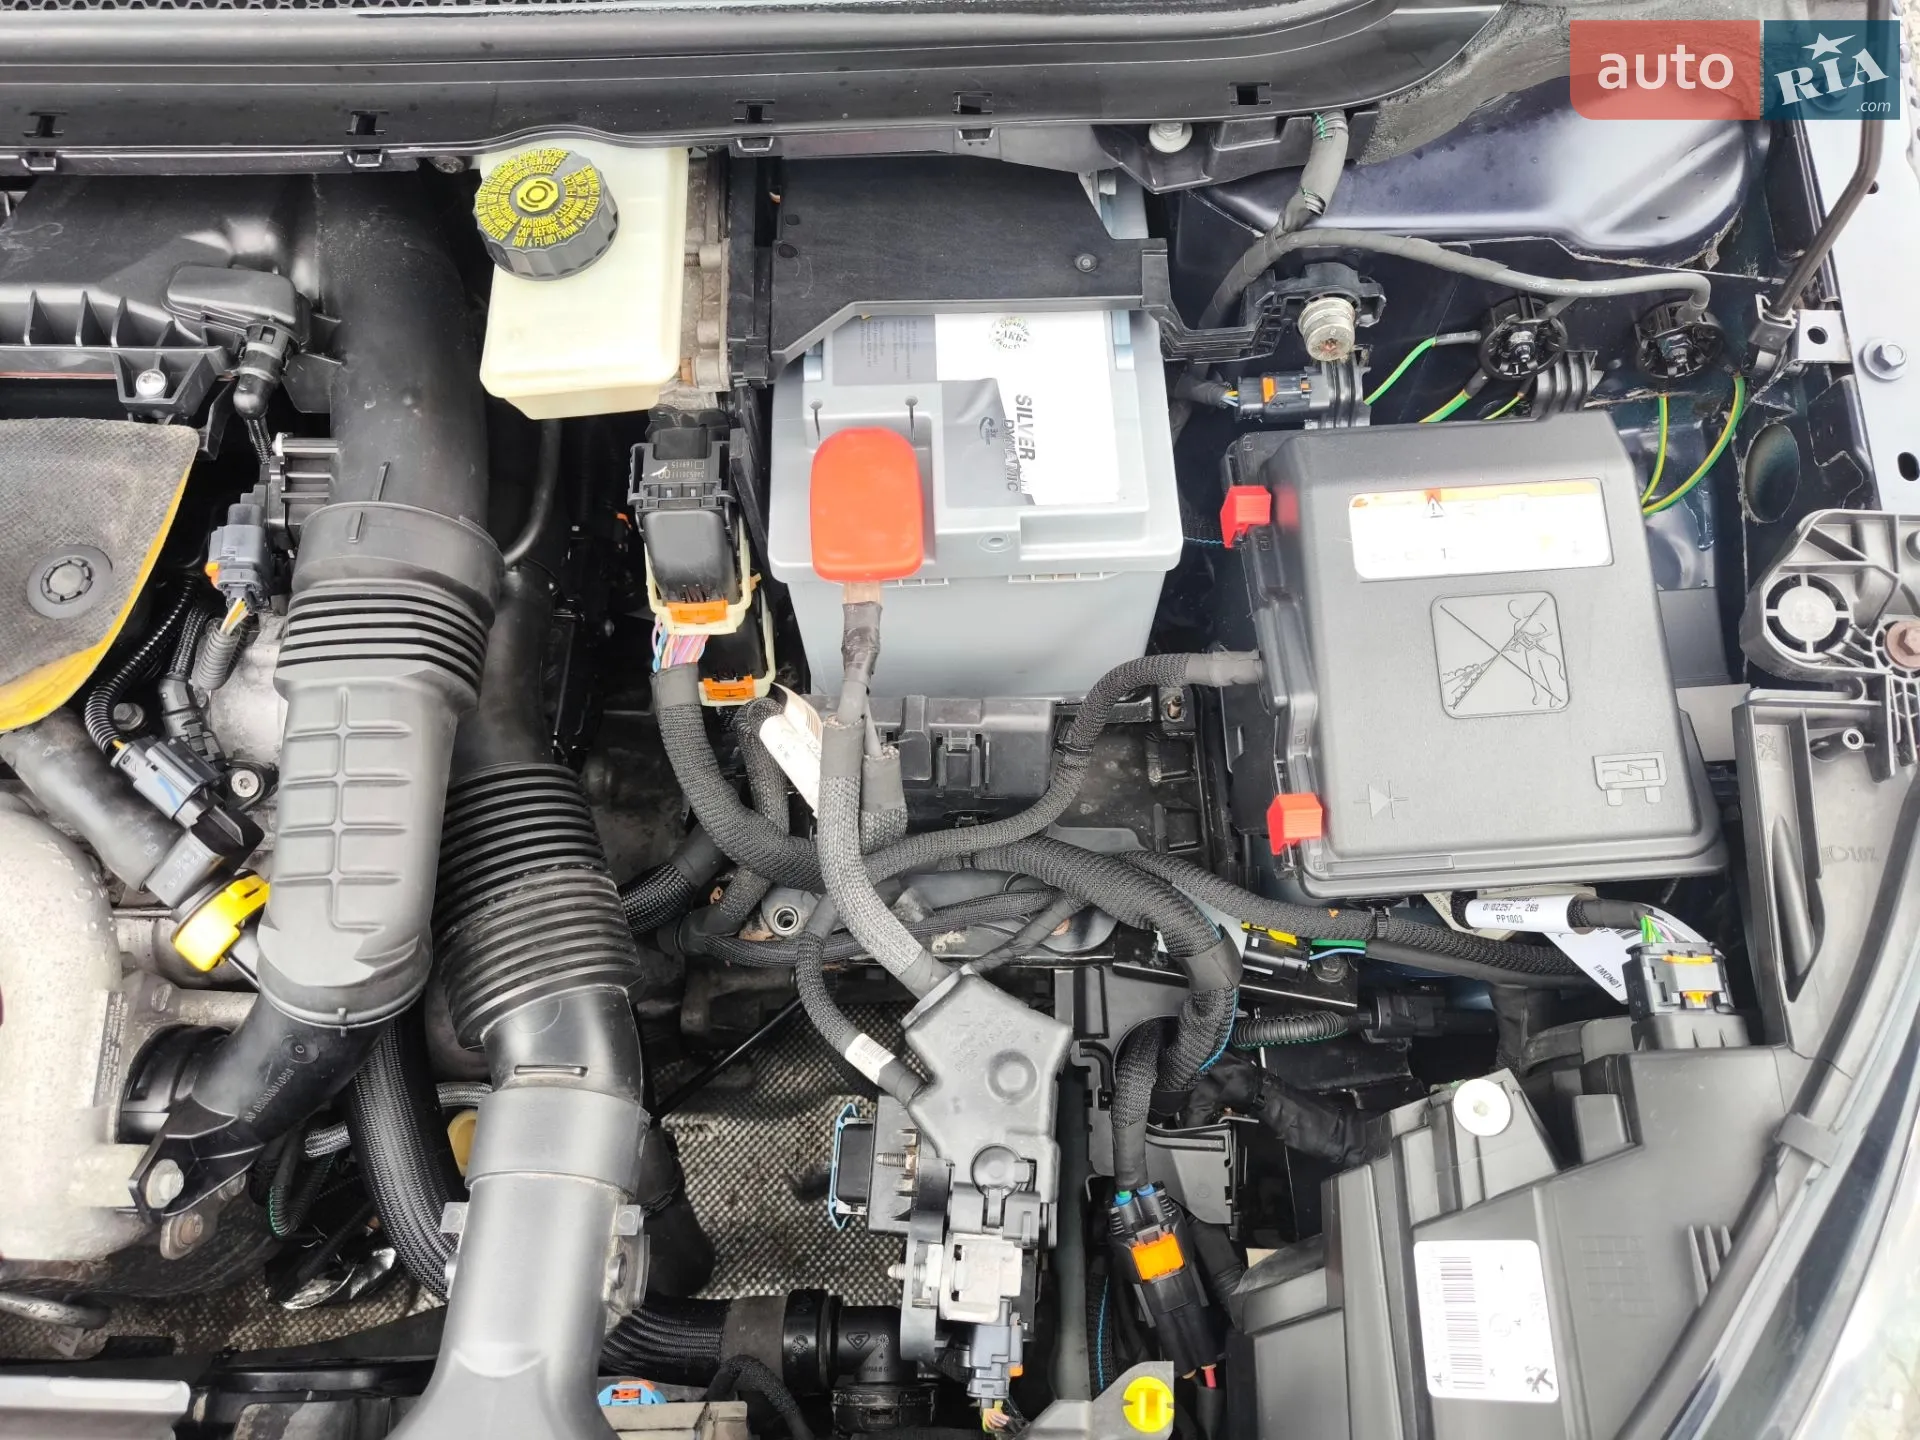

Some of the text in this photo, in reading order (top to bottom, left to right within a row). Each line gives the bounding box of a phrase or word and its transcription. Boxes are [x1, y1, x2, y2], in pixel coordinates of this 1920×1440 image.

[520, 214, 557, 228] WARNING
[555, 199, 576, 218] CLEAN
[580, 197, 599, 220] SEALED
[517, 226, 532, 238] CAP
[532, 222, 560, 237] BEFORE
[577, 219, 585, 228] A
[534, 235, 557, 247] FLUID
[556, 224, 578, 241] FROM
[512, 237, 527, 247] DOT
[1015, 394, 1036, 461] SILVER
[1003, 419, 1019, 492] DYNAMIC
